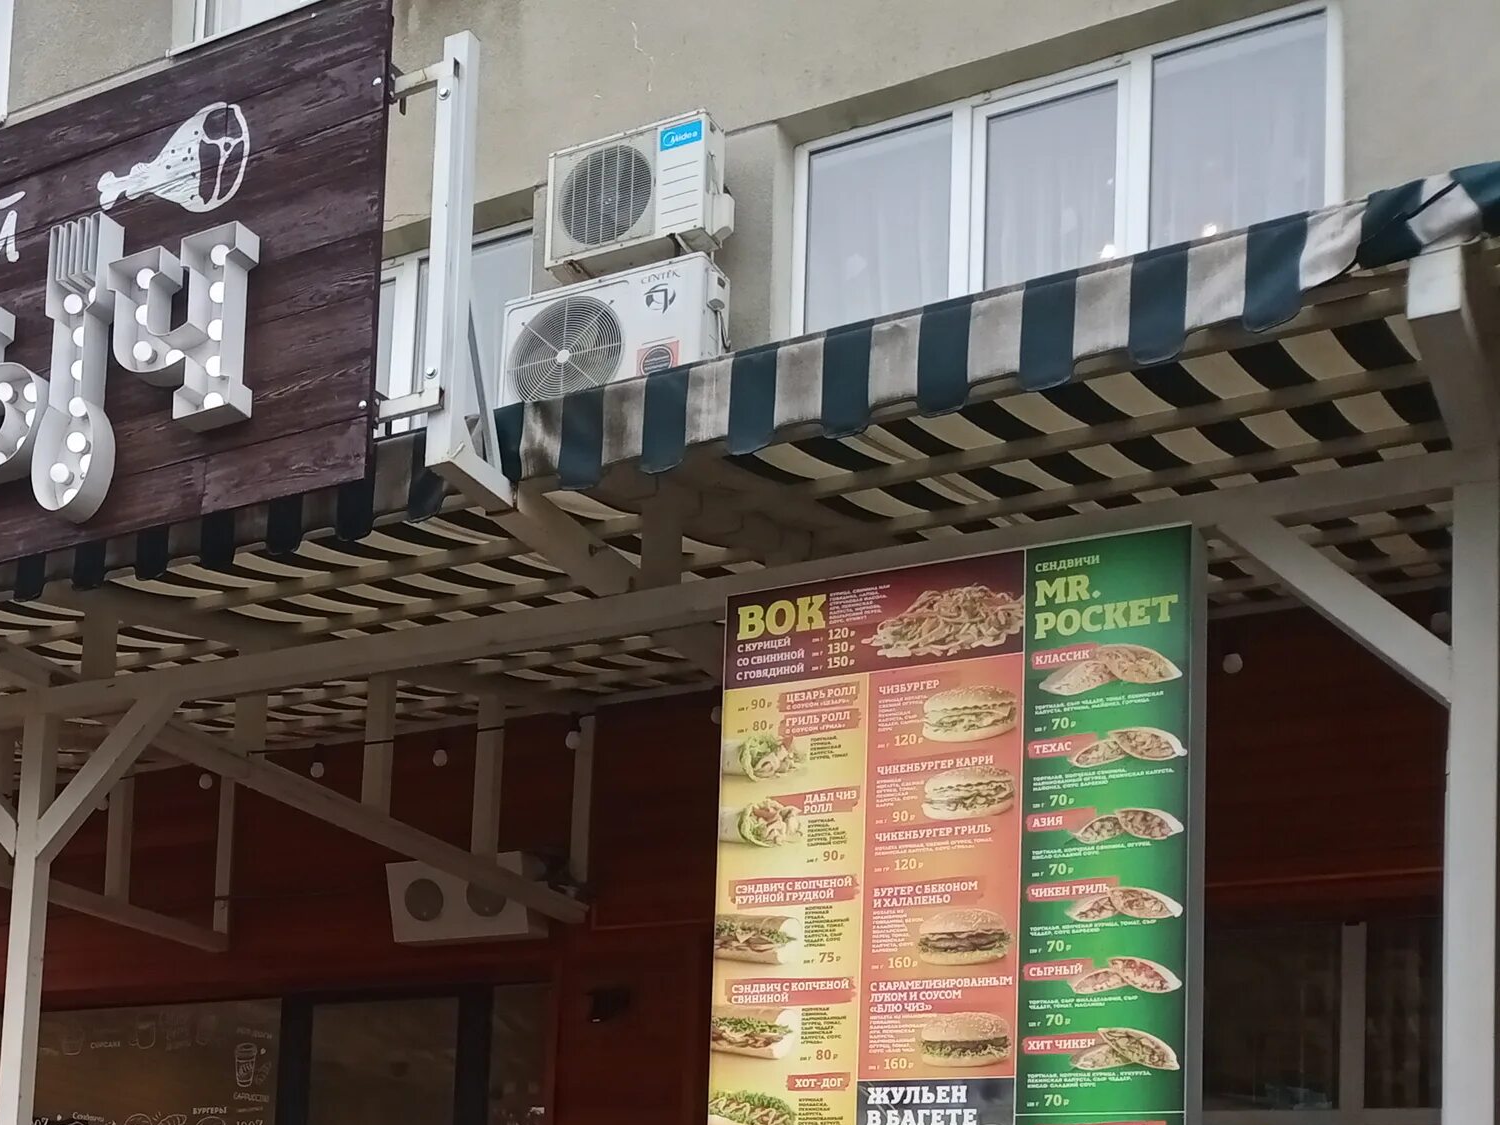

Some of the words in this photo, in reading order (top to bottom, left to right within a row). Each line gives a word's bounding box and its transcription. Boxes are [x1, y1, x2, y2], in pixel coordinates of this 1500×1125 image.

[1035, 554, 1100, 573] СЕНДВИЧИ
[1034, 574, 1102, 606] MR.
[736, 594, 827, 640] ВОК
[1034, 594, 1179, 640] POCKET
[745, 637, 791, 654] КУРИЦЕЙ
[737, 657, 748, 667] СО
[749, 648, 805, 666] СВИНИНОЙ
[1035, 649, 1090, 665] КЛАССИК
[744, 663, 805, 681] ГОВЯДИНОЙ
[785, 690, 826, 703] ЦЕЗАРЬ
[827, 685, 856, 698] РОЛЛ
[879, 679, 940, 695] ЧИЗБУРГЕР
[785, 714, 820, 727] ГРИЛЬ
[821, 711, 850, 721] РОЛЛ
[1034, 741, 1072, 754] ТЕХАС
[877, 759, 956, 775] ЧИКЕНБУРГЕР
[957, 755, 993, 768] КАРРИ
[804, 792, 834, 804] ДАБЛ
[836, 790, 857, 800] ЧИЗ
[804, 803, 833, 814] РОЛЛ
[1032, 815, 1063, 828] АЗИЯ
[875, 826, 953, 842] ЧИКЕНБУРГЕР
[954, 823, 991, 836] ГРИЛЬ
[735, 883, 785, 895] СЭНДВИЧ
[794, 876, 853, 891] КОПЧЕНОЙ
[873, 884, 914, 897] БУРГЕР
[923, 881, 978, 894] БЕКОНОМ
[1031, 885, 1070, 898] ЧИКЕН
[735, 891, 785, 904] КУРИНОЙ
[785, 889, 835, 903] ГРУДКОЙ
[882, 894, 951, 908] ХАЛАПЕНЬО
[1029, 963, 1083, 977] СЫРНЫЙ
[732, 982, 781, 994] СЭНДВИЧ
[790, 979, 849, 992] КОПЧЕНОЙ
[878, 976, 1013, 993] КАРАМЕЛИЗИРОВАННЫМ
[732, 992, 789, 1004] СВИНИНОЙ
[870, 992, 907, 1003] ЛУКОМ
[920, 989, 962, 1000] СОУСОМ
[870, 1004, 903, 1013] «БЛЮ
[904, 1002, 932, 1013] ЧИЗ»
[1028, 1039, 1053, 1051] ХИТ
[1054, 1038, 1095, 1050] ЧИКЕН
[794, 1077, 843, 1089] ХОТ-ДОГ
[866, 1085, 968, 1105] ЖУЛЬЕН
[193, 1106, 228, 1115] БУРГЕРЫ
